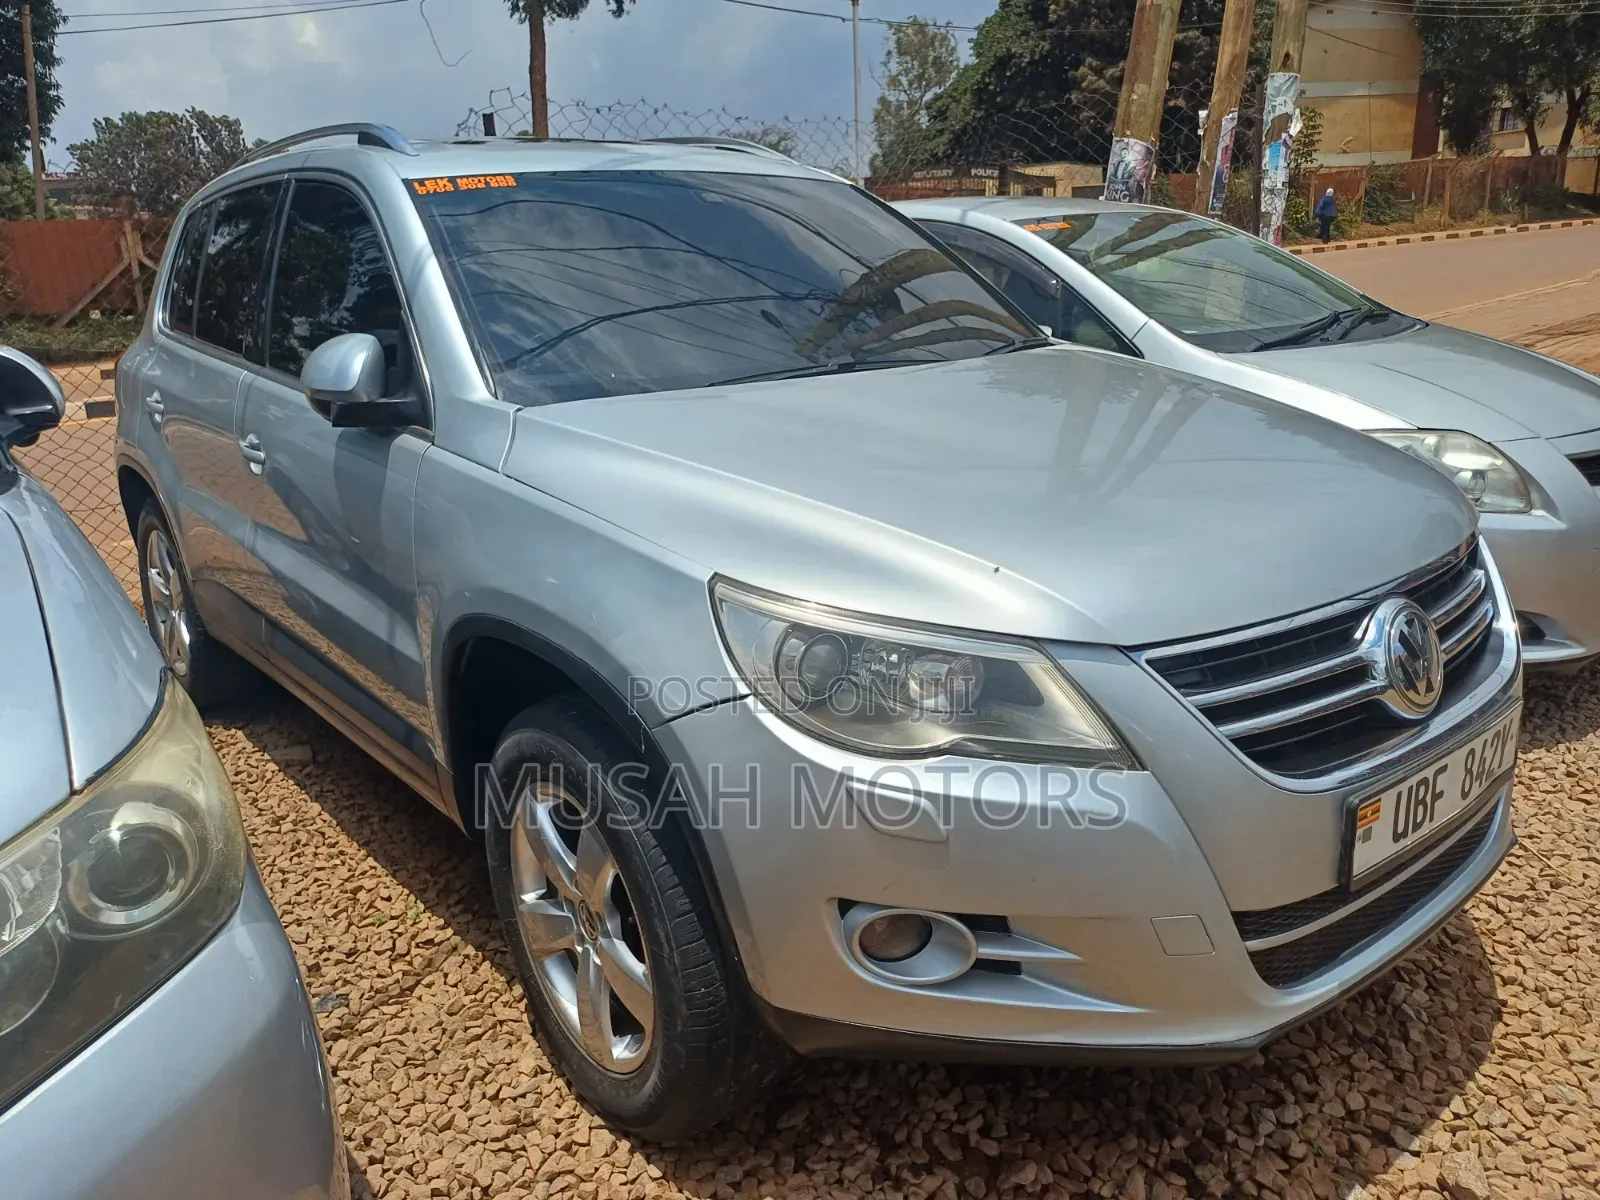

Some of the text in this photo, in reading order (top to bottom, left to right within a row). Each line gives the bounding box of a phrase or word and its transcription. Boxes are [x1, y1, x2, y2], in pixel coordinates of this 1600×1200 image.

[970, 168, 999, 177] POLICE
[413, 175, 515, 190] LEK MOTORS
[1392, 718, 1514, 844] UBF 842Y
